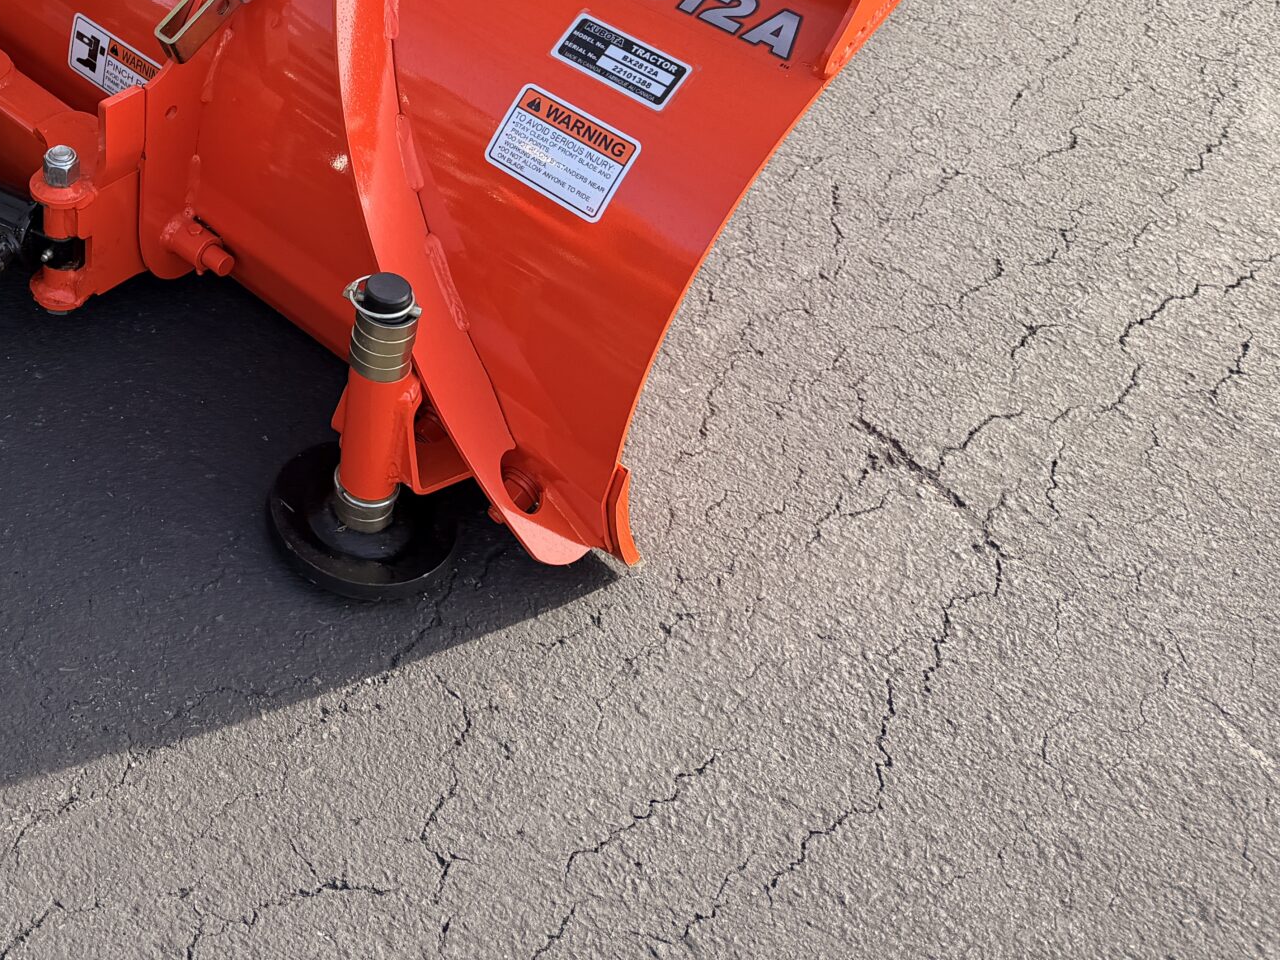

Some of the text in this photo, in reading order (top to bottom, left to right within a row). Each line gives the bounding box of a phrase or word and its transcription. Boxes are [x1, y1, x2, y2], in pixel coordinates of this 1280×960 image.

[107, 60, 133, 83] PINCH
[122, 47, 158, 79] WARNIN
[564, 41, 652, 89] SERIAL No. 22101388
[573, 30, 659, 78] MODEL No. BX2812A
[584, 22, 678, 73] KUBOTA TRACTOR
[582, 62, 601, 74] CANADA
[628, 84, 636, 92] AU
[635, 88, 655, 102] CANADA
[504, 140, 531, 158] WORKING
[510, 127, 529, 140] PINCH
[515, 121, 530, 132] STAY
[529, 130, 549, 144] CLEAR
[557, 146, 578, 160] FRONT
[578, 158, 598, 173] BLADE
[597, 169, 612, 180] AND
[516, 111, 616, 174] TO AVOID SERIOUS INJURY:
[546, 104, 626, 158] WARNING
[497, 152, 507, 161] ON
[500, 146, 591, 203] DO NOT ALLOW ANYONE TO RIDE
[507, 133, 517, 142] DO
[588, 180, 605, 194] NEAR
